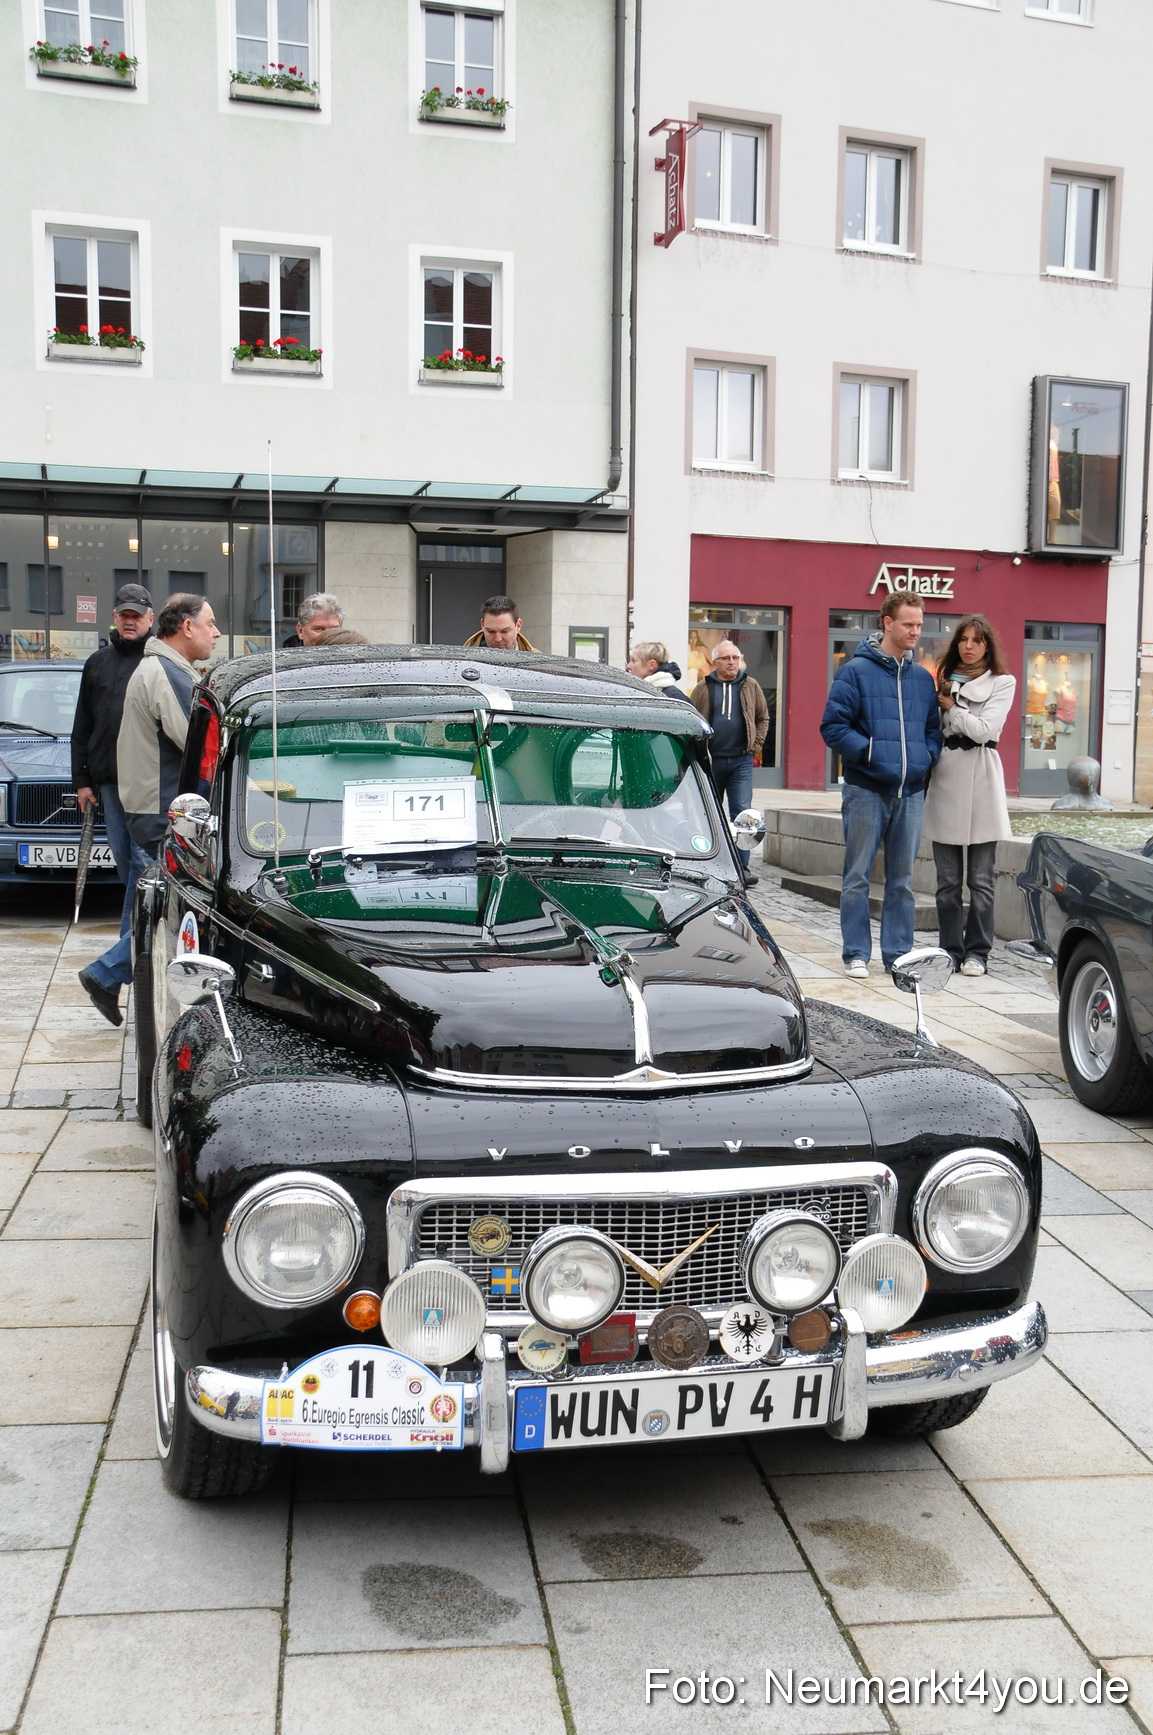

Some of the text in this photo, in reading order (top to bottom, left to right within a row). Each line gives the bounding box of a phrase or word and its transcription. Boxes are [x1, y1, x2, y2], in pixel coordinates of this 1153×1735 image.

[668, 152, 680, 228] Achatz
[382, 566, 398, 578] 22
[869, 562, 955, 596] Achatz
[404, 795, 444, 811] 171
[34, 847, 43, 862] R
[56, 847, 76, 863] VB
[486, 1136, 815, 1161] VOLVO
[348, 1360, 375, 1398] 11
[302, 1398, 346, 1429] 6.Euregio
[349, 1408, 389, 1428] Egrensis
[391, 1401, 425, 1425] Classic
[525, 1425, 535, 1439] D
[550, 1387, 639, 1440] WUN
[677, 1380, 735, 1430] PV
[750, 1378, 774, 1423] 4
[793, 1374, 822, 1419] H
[343, 1433, 393, 1441] SCHERDEL
[410, 1433, 454, 1441] Knoll
